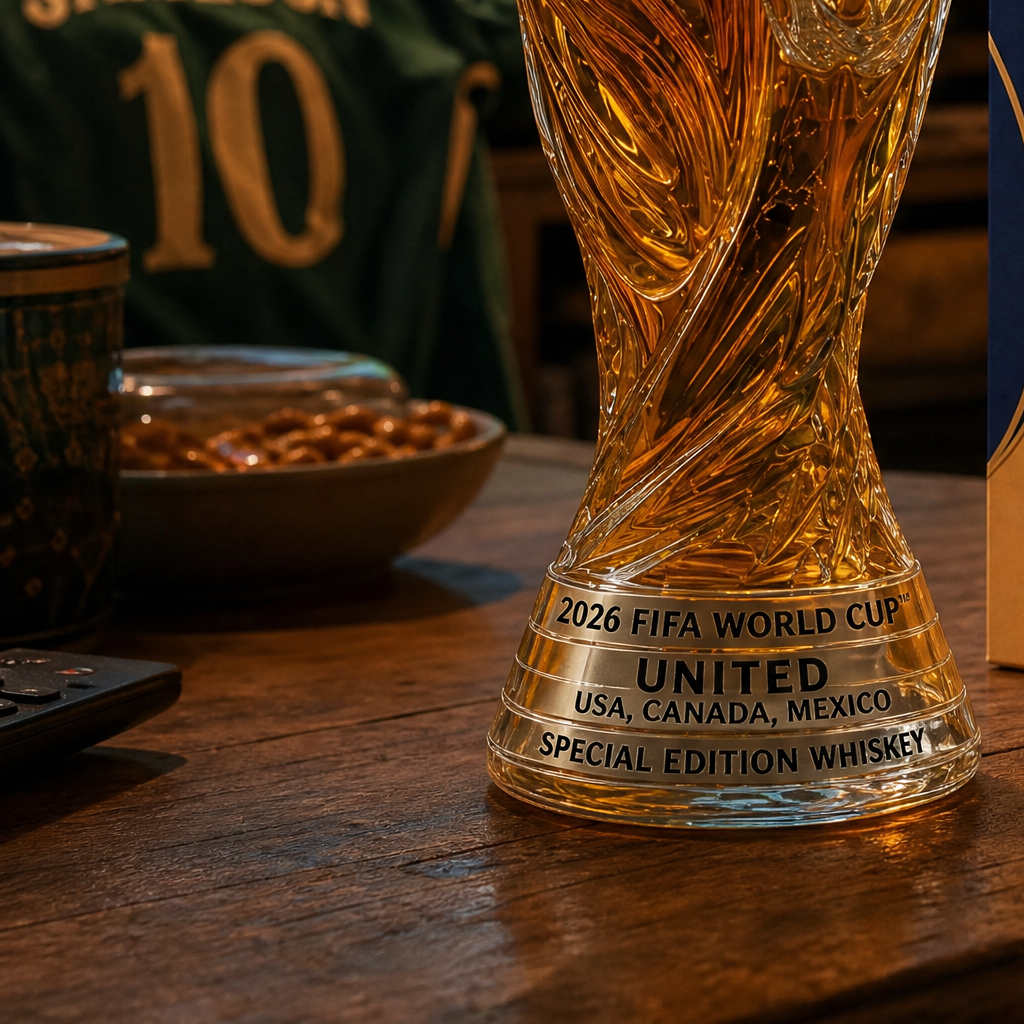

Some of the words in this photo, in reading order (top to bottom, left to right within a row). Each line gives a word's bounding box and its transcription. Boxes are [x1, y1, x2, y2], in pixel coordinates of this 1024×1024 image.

[118, 29, 347, 273] 10
[556, 596, 621, 633] 2026
[631, 608, 702, 639] FIFA
[713, 607, 837, 639] WORLD
[636, 657, 829, 695] UNITED
[574, 690, 634, 725] USA,
[642, 699, 778, 728] CANADA,
[787, 689, 892, 722] MEXICO
[539, 731, 652, 773] SPECIAL
[663, 745, 798, 776] EDITION
[810, 727, 926, 771] WHISKEY
